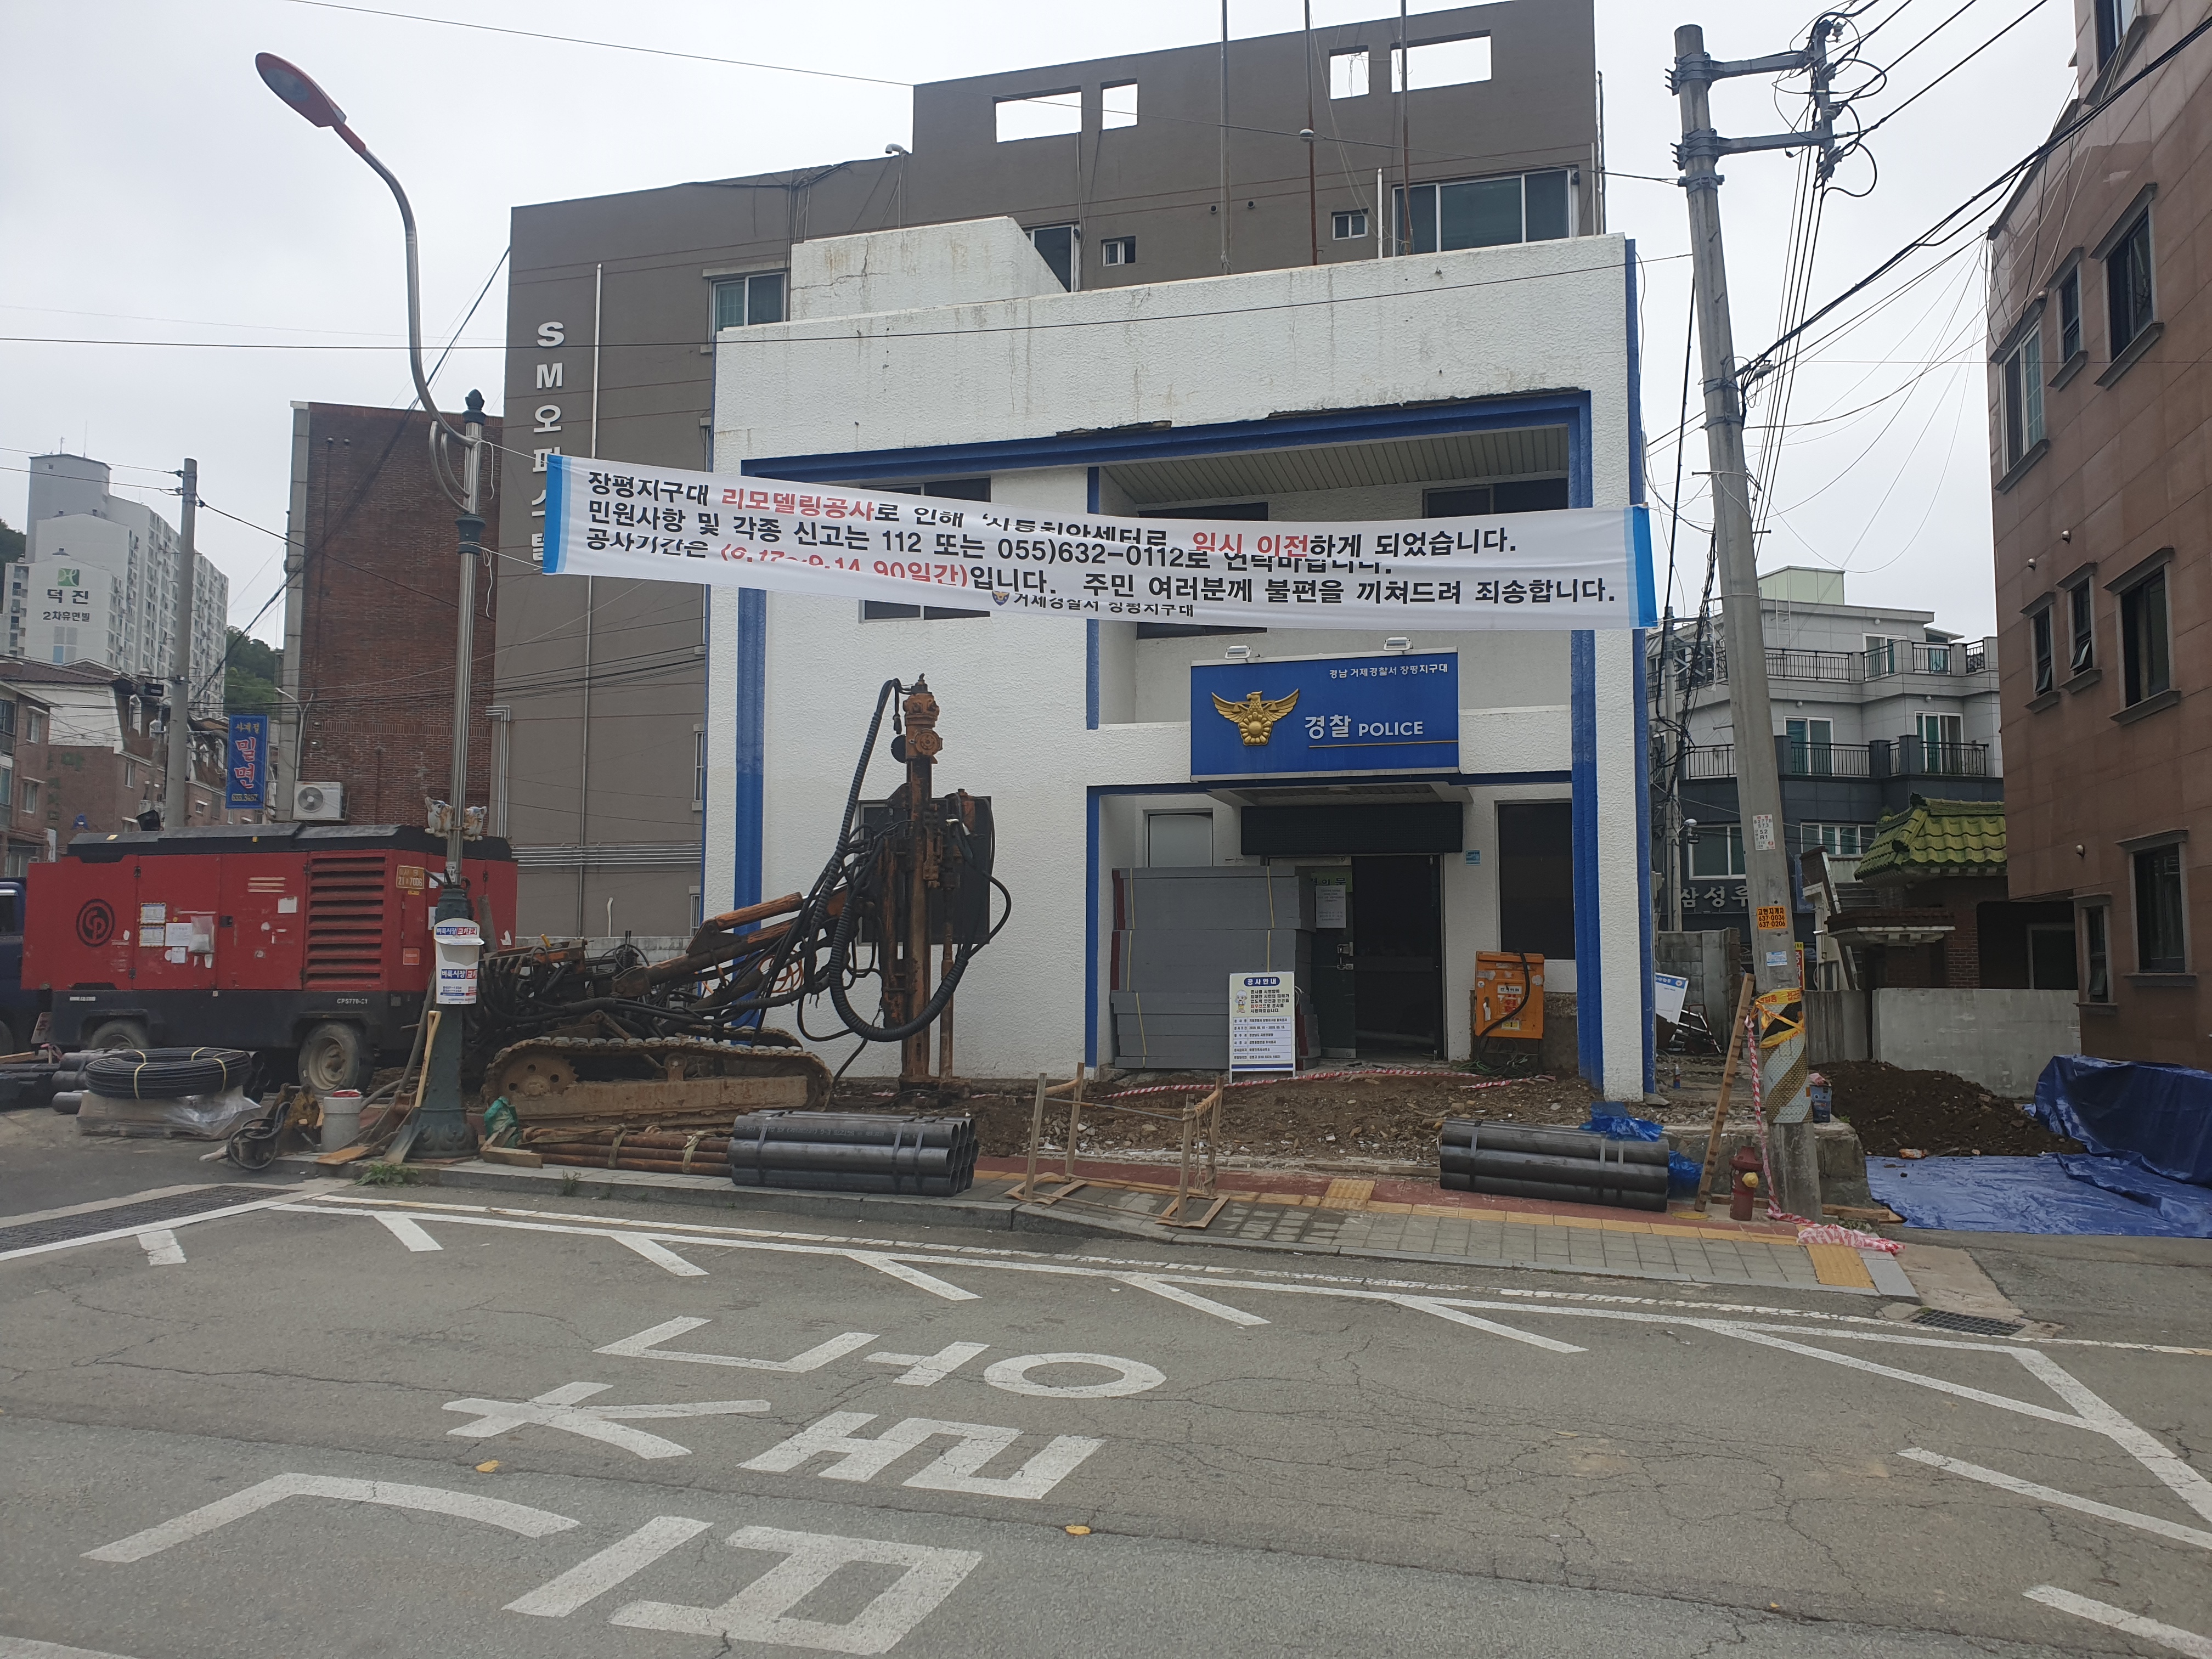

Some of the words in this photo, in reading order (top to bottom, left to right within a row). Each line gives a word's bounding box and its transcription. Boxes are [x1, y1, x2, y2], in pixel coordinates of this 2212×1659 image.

[588, 471, 709, 506] 장평지구대
[721, 488, 900, 522] 리모델링공사로
[914, 507, 964, 528] 인해
[1257, 533, 1362, 558] 이전하게
[1374, 527, 1516, 557] 되었습니다.
[589, 500, 686, 533] 민원사항
[697, 512, 719, 537] 및
[733, 516, 782, 543] 각종
[793, 521, 870, 551] 신고는
[882, 530, 922, 553] 112
[934, 533, 985, 559] 또는
[586, 527, 709, 558] 공사기간은
[1083, 572, 1134, 597] 주민
[1149, 575, 1252, 603] 여러분께
[1265, 579, 1344, 603] 불편을
[1356, 579, 1461, 605] 끼쳐드려
[1475, 578, 1615, 604] 죄송합니다.
[1329, 668, 1347, 680] 경남
[1350, 665, 1397, 678] 거제경찰서
[1400, 663, 1449, 676] 장평지구대
[1305, 715, 1352, 740] 경찰
[1358, 721, 1424, 737] POLICE
[234, 736, 256, 789] 밀면
[442, 970, 465, 978] 벼룩시장
